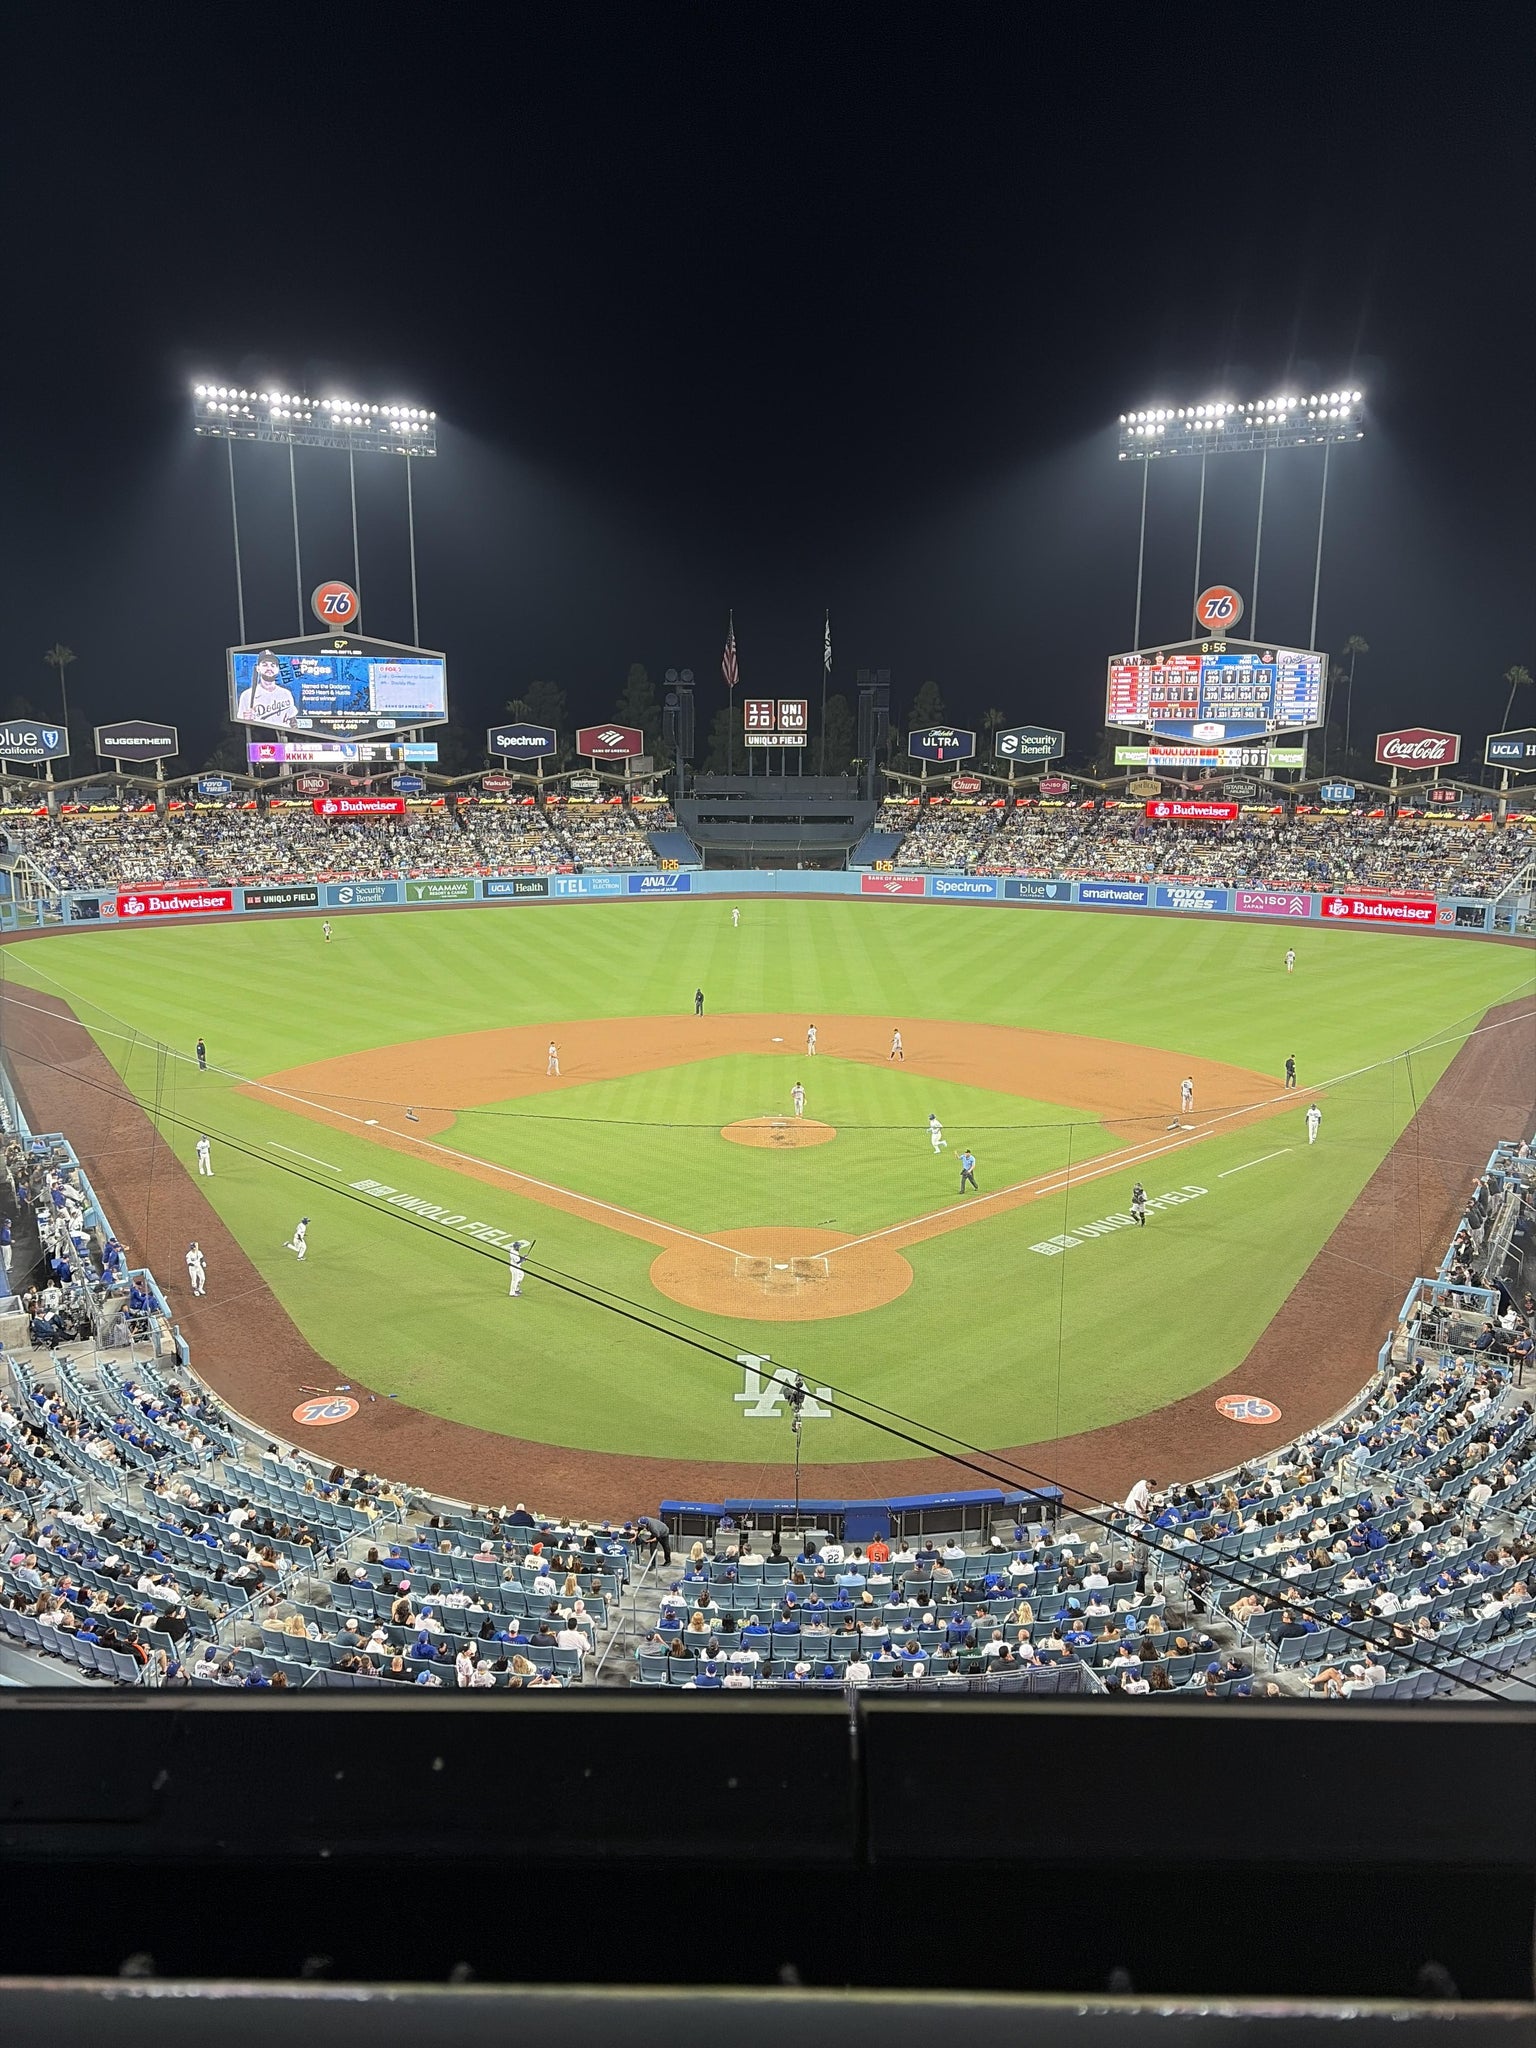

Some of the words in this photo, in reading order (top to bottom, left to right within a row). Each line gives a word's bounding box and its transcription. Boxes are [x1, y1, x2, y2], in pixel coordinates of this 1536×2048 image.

[323, 592, 351, 615] 76
[1204, 595, 1233, 619] 76
[1201, 642, 1227, 653] 8:56
[301, 658, 318, 666] Andy
[301, 665, 331, 676] Pages
[1242, 675, 1251, 683] 35
[254, 699, 291, 719] Dodgers
[748, 704, 770, 714] ユニ
[781, 704, 802, 715] UNI
[748, 715, 770, 726] クロ
[781, 715, 804, 728] QLO
[104, 737, 172, 745] GUGGENHEIM
[496, 735, 547, 748] Spectrum
[748, 736, 778, 746] UNIQLO
[779, 736, 804, 745] FIELD
[922, 737, 960, 747] ULTRA
[1020, 734, 1058, 747] Security
[1020, 744, 1052, 755] Benefit
[1382, 737, 1450, 760] Coca-Cola
[1492, 745, 1520, 755] UCLA
[302, 780, 324, 788] JINRO
[484, 779, 511, 788] Yakult
[952, 780, 979, 791] Churu
[1325, 787, 1351, 799] TEL
[340, 801, 398, 812] Budweiser
[1172, 804, 1231, 817] Budweiser
[662, 859, 679, 870] 0:26
[876, 861, 894, 871] 0:26
[491, 884, 511, 892] UCLA
[515, 882, 544, 892] Health
[557, 879, 588, 893] TEL
[640, 876, 666, 887] ANA
[935, 880, 990, 894] Spectrum
[355, 885, 386, 895] Security
[1019, 883, 1045, 895] blue
[1082, 888, 1145, 901] smartwater
[1166, 888, 1205, 899] TOYO
[148, 895, 226, 911] Budweiser
[263, 893, 293, 904] UNIQLO
[293, 892, 316, 902] FIELD
[356, 893, 383, 902] Benefit
[1243, 895, 1286, 906] DAISO
[102, 904, 115, 914] 76
[1171, 898, 1216, 909] TIRES
[1353, 902, 1432, 919] Budweiser
[1439, 911, 1453, 921] 76
[1151, 1185, 1209, 1210] FIELD
[386, 1193, 467, 1225] UNIQLO
[734, 1354, 833, 1418] LA
[301, 1399, 352, 1422] 76
[1224, 1398, 1274, 1419] 76
[827, 1553, 840, 1564] 22
